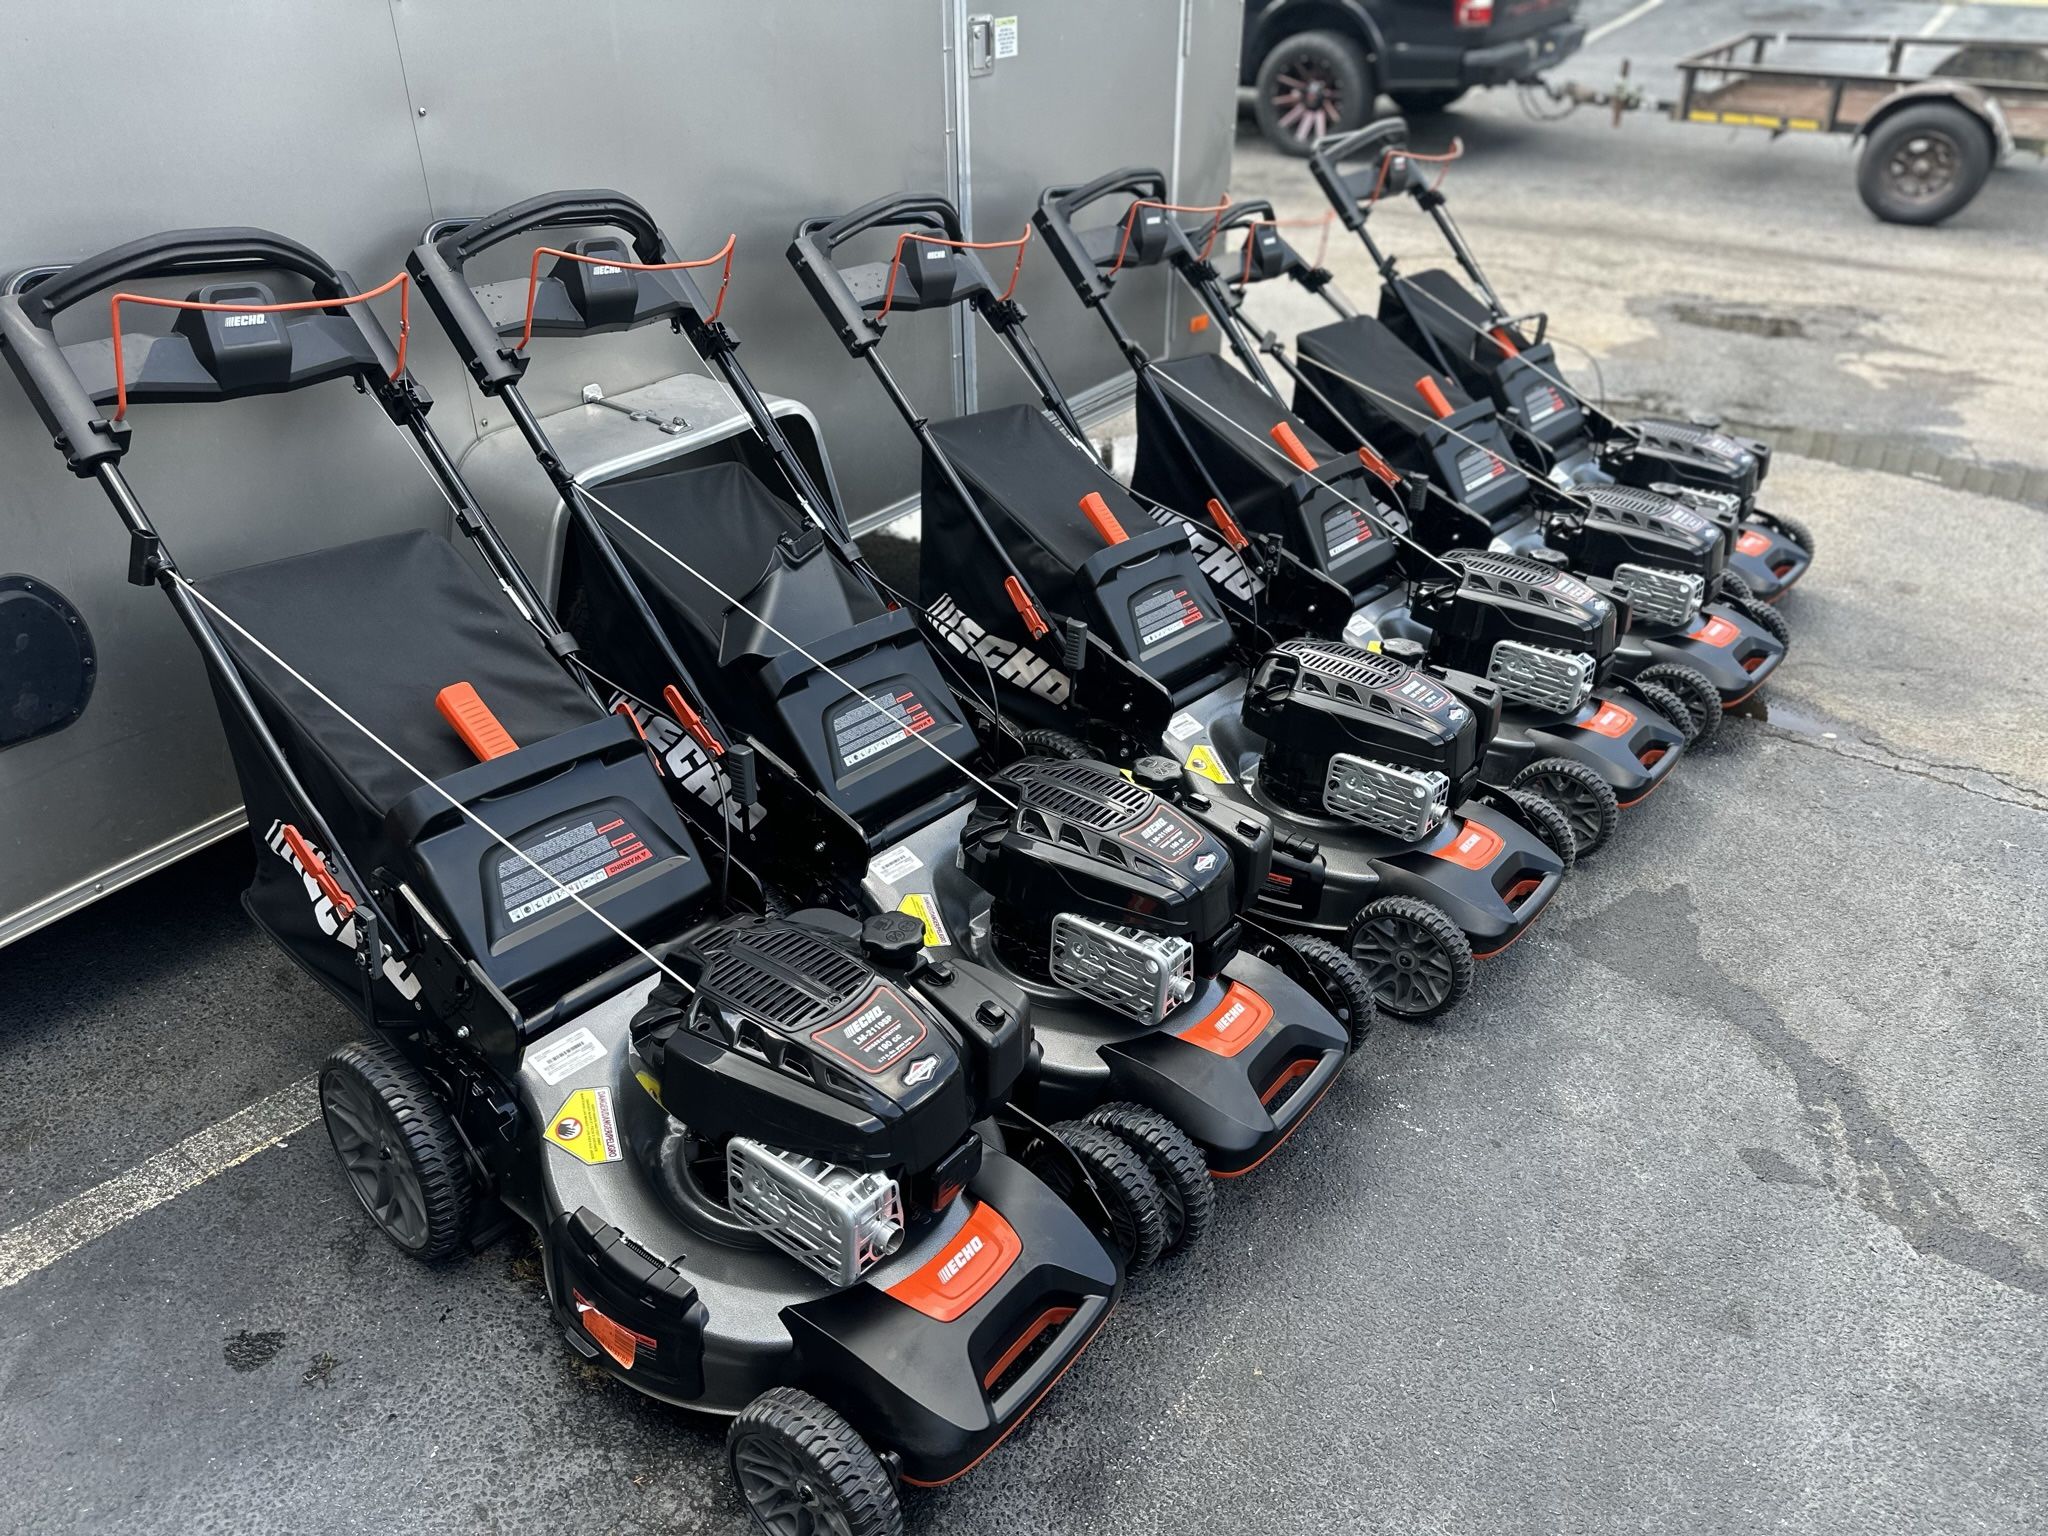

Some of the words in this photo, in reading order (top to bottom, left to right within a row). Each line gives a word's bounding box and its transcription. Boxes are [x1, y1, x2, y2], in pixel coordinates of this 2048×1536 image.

[233, 313, 265, 327] ECHO
[946, 616, 1071, 705] ECHO
[609, 855, 642, 874] WARNING
[854, 1005, 884, 1034] ECHO
[1220, 1002, 1246, 1029] ECHO
[852, 1015, 893, 1046] LM-2119SP
[946, 1235, 984, 1275] ECHO
